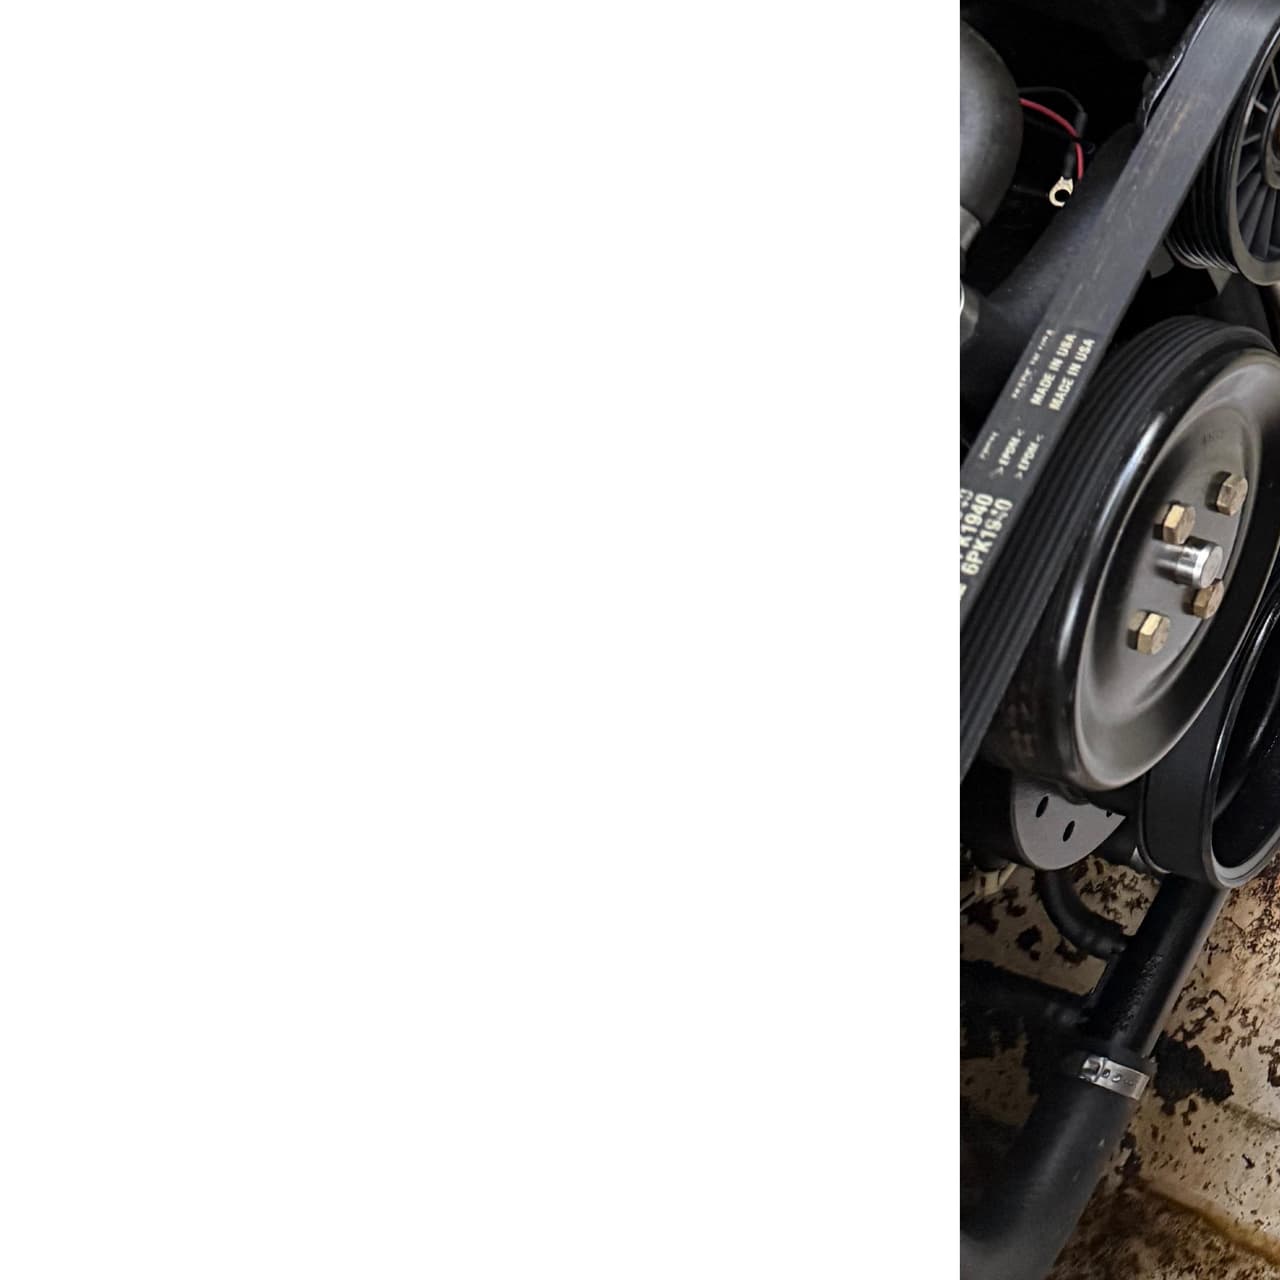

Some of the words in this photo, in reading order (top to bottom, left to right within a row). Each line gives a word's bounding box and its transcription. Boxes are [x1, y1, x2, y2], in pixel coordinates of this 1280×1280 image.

[1030, 372, 1056, 406] MADE
[1048, 354, 1063, 373] IN
[1059, 333, 1077, 357] USA
[1048, 376, 1075, 411] MADE
[1066, 359, 1082, 377] IN
[1078, 338, 1095, 363] USA
[960, 493, 993, 558] K1940
